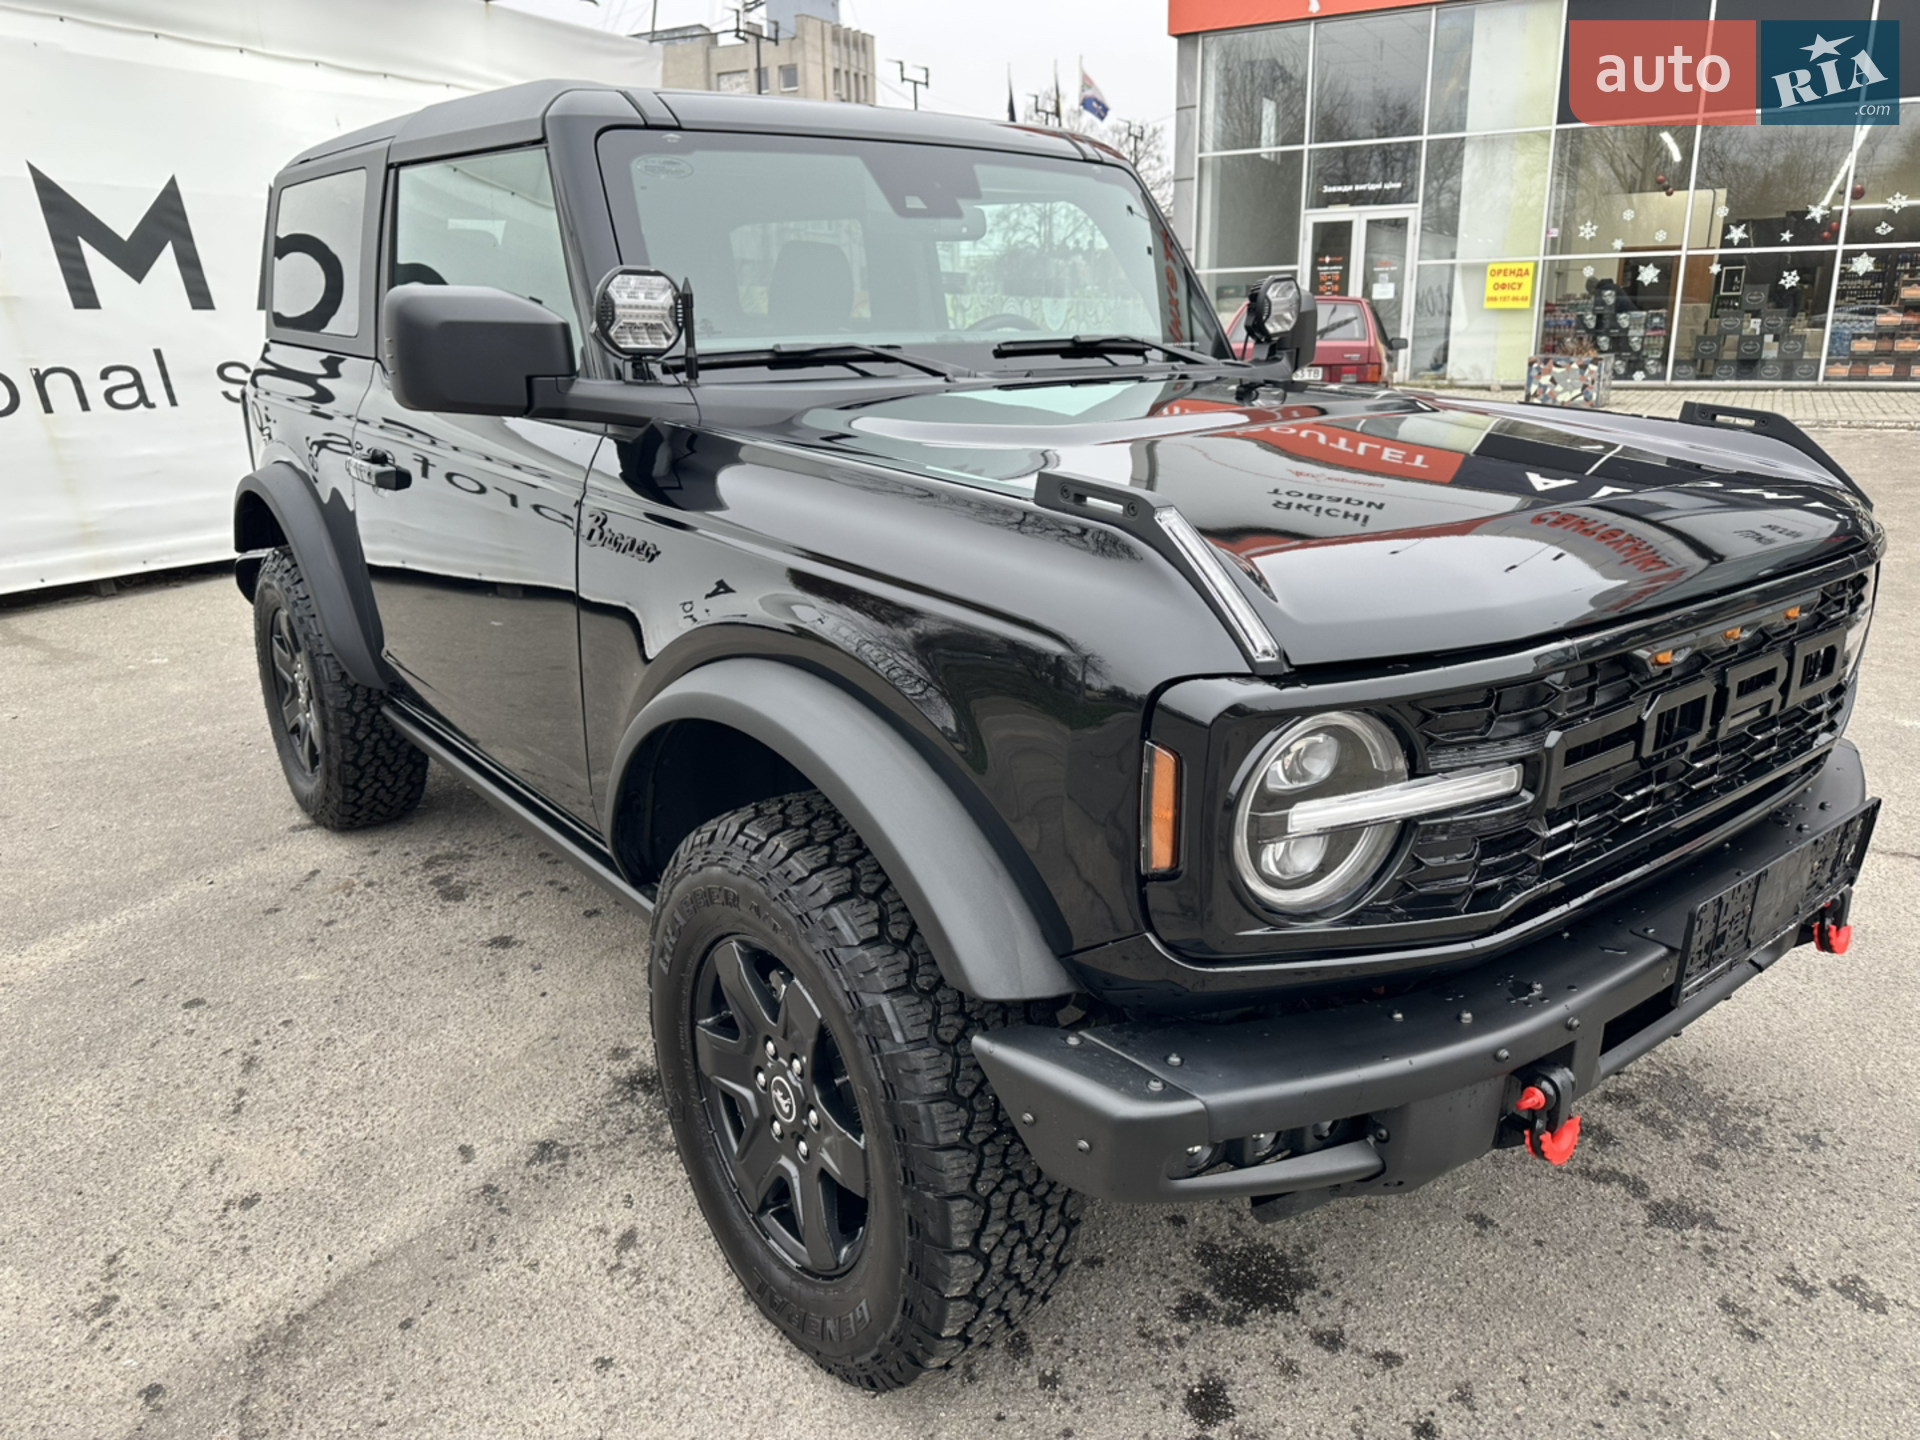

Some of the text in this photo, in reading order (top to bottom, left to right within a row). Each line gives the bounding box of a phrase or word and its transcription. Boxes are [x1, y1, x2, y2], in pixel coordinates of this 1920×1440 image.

[1489, 268, 1530, 278] ОРЕНДА
[1492, 282, 1523, 291] ОФІСУ
[1546, 622, 1848, 810] FORD
[752, 1267, 872, 1342] GENERAL
